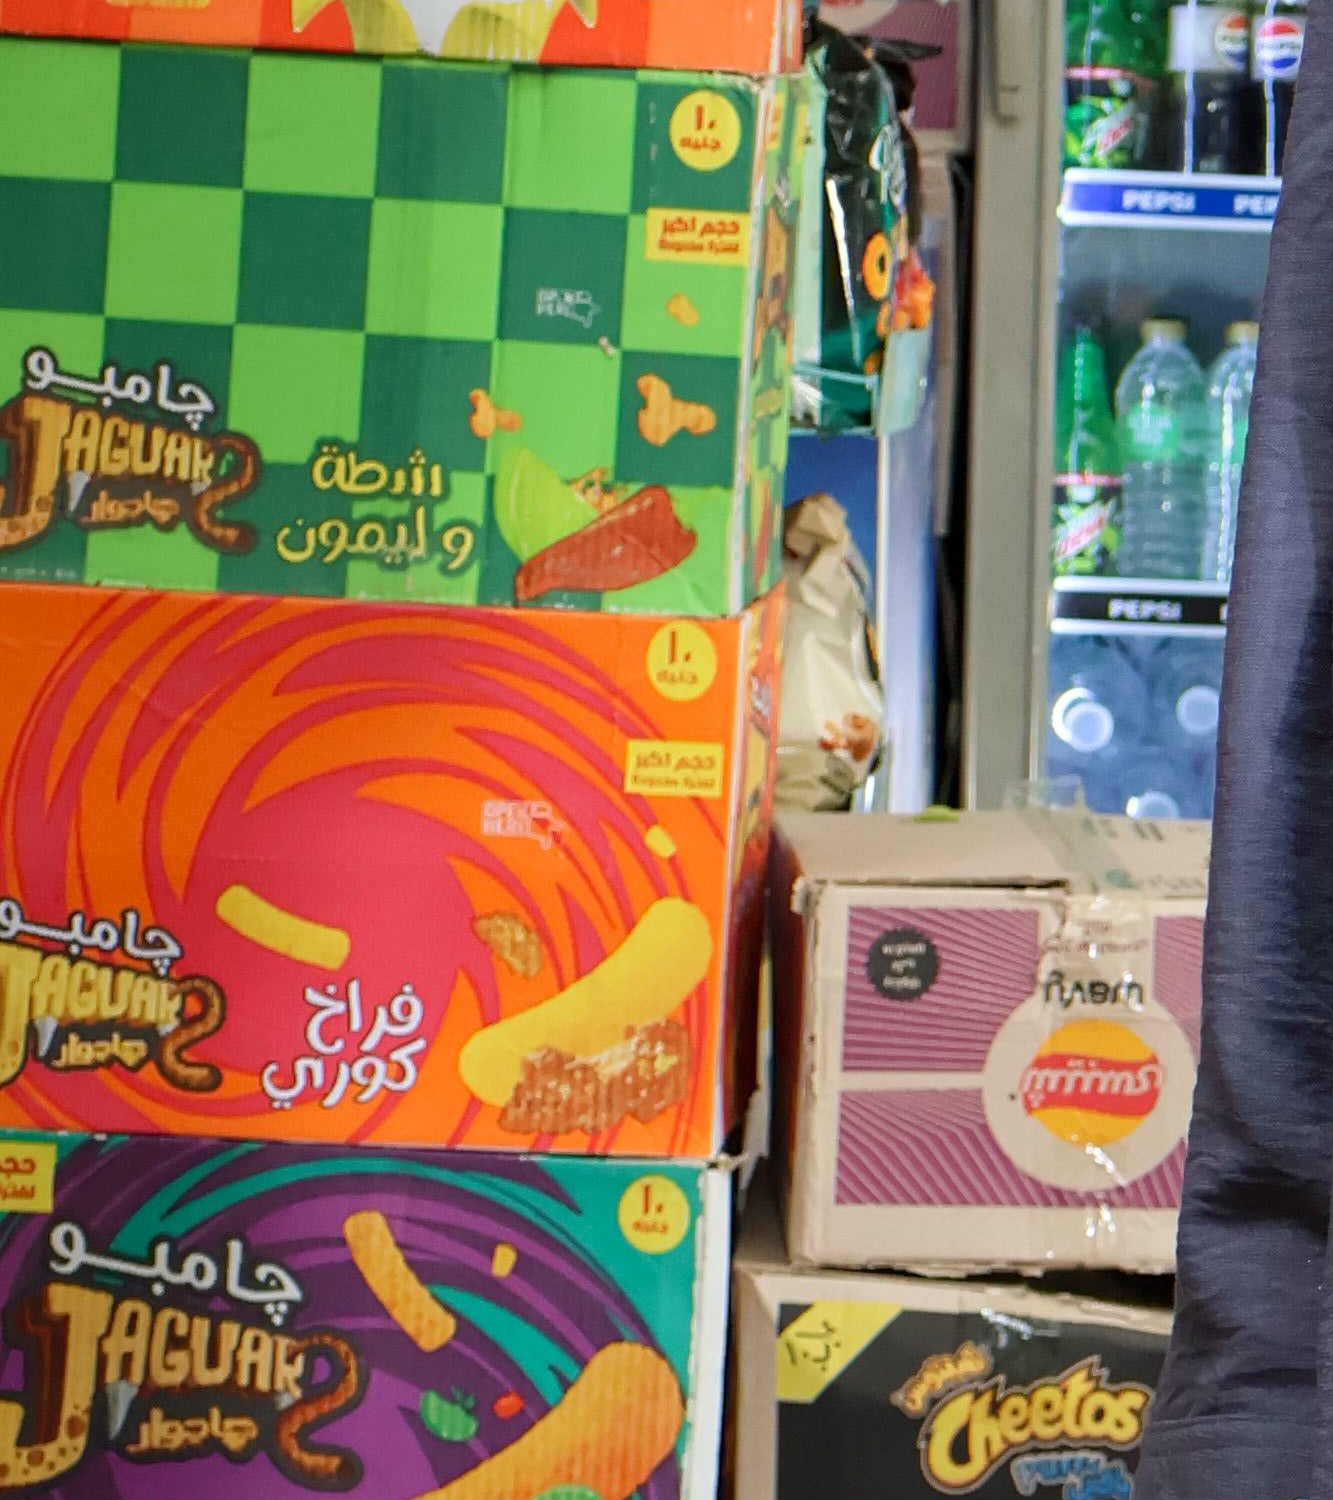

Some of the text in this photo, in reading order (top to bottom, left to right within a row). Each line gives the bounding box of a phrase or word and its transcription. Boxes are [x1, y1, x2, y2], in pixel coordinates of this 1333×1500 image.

[1122, 189, 1280, 215] PEPSI PEP
[0, 394, 214, 549] JAGUAR
[276, 503, 427, 565] ليمون
[1108, 598, 1182, 621] PEPSI
[304, 978, 425, 1056] فراخ
[262, 1037, 427, 1110] كوري
[0, 1157, 36, 1178] حج
[0, 1281, 305, 1489] JAGUAR
[925, 1360, 1152, 1489] Cheetos
